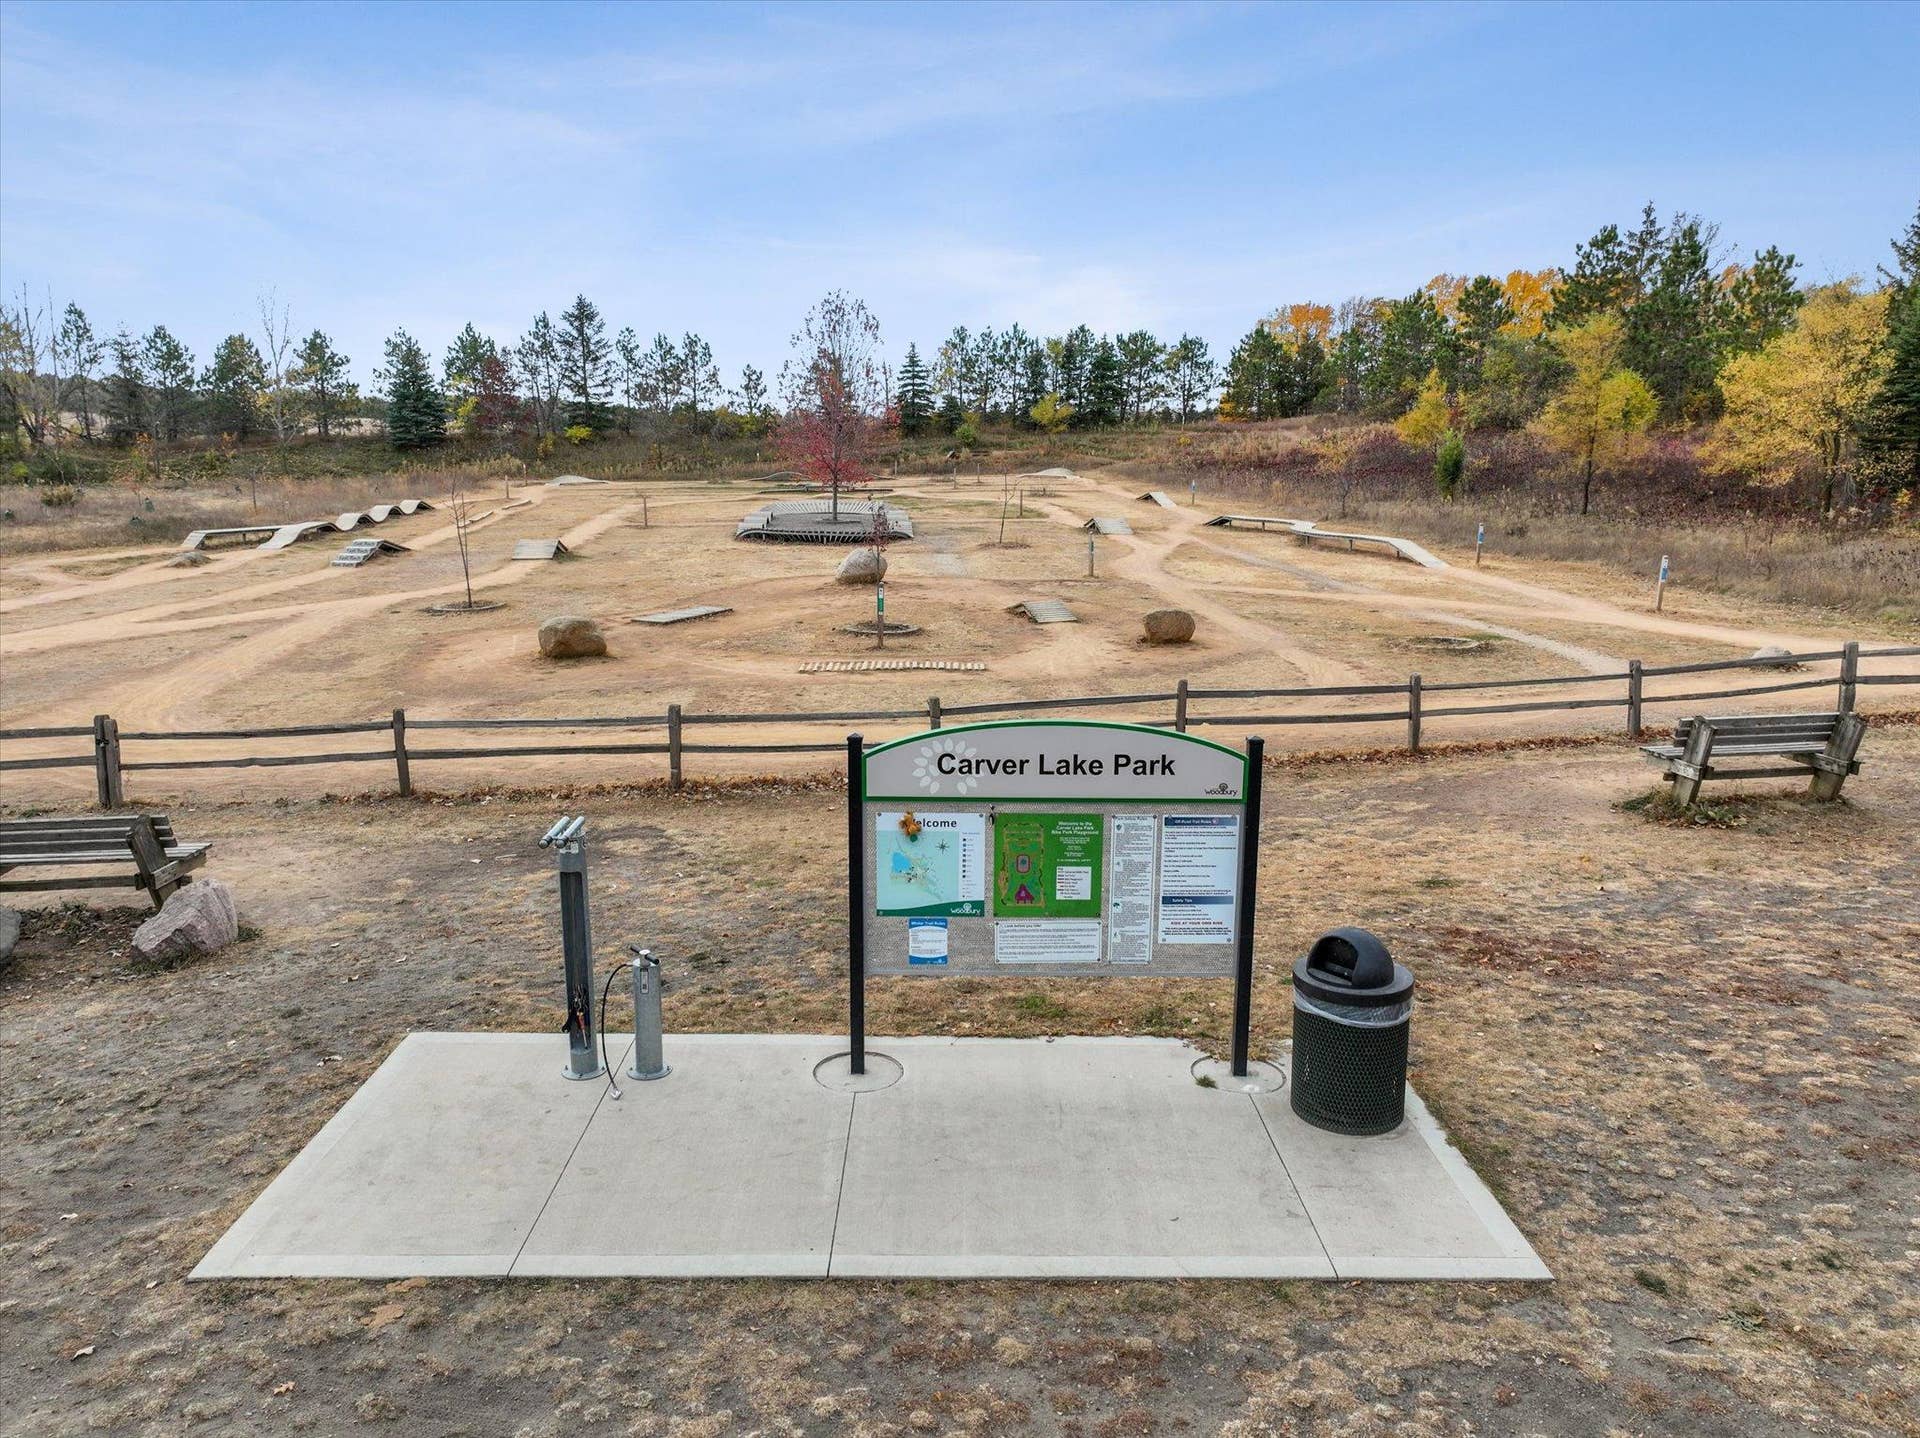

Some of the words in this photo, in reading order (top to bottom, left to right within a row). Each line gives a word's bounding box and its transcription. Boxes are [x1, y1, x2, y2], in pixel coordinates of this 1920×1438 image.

[936, 753, 1030, 776] Carver
[1038, 753, 1104, 776] Lake
[1113, 753, 1176, 776] Park
[913, 818, 957, 828] elcome
